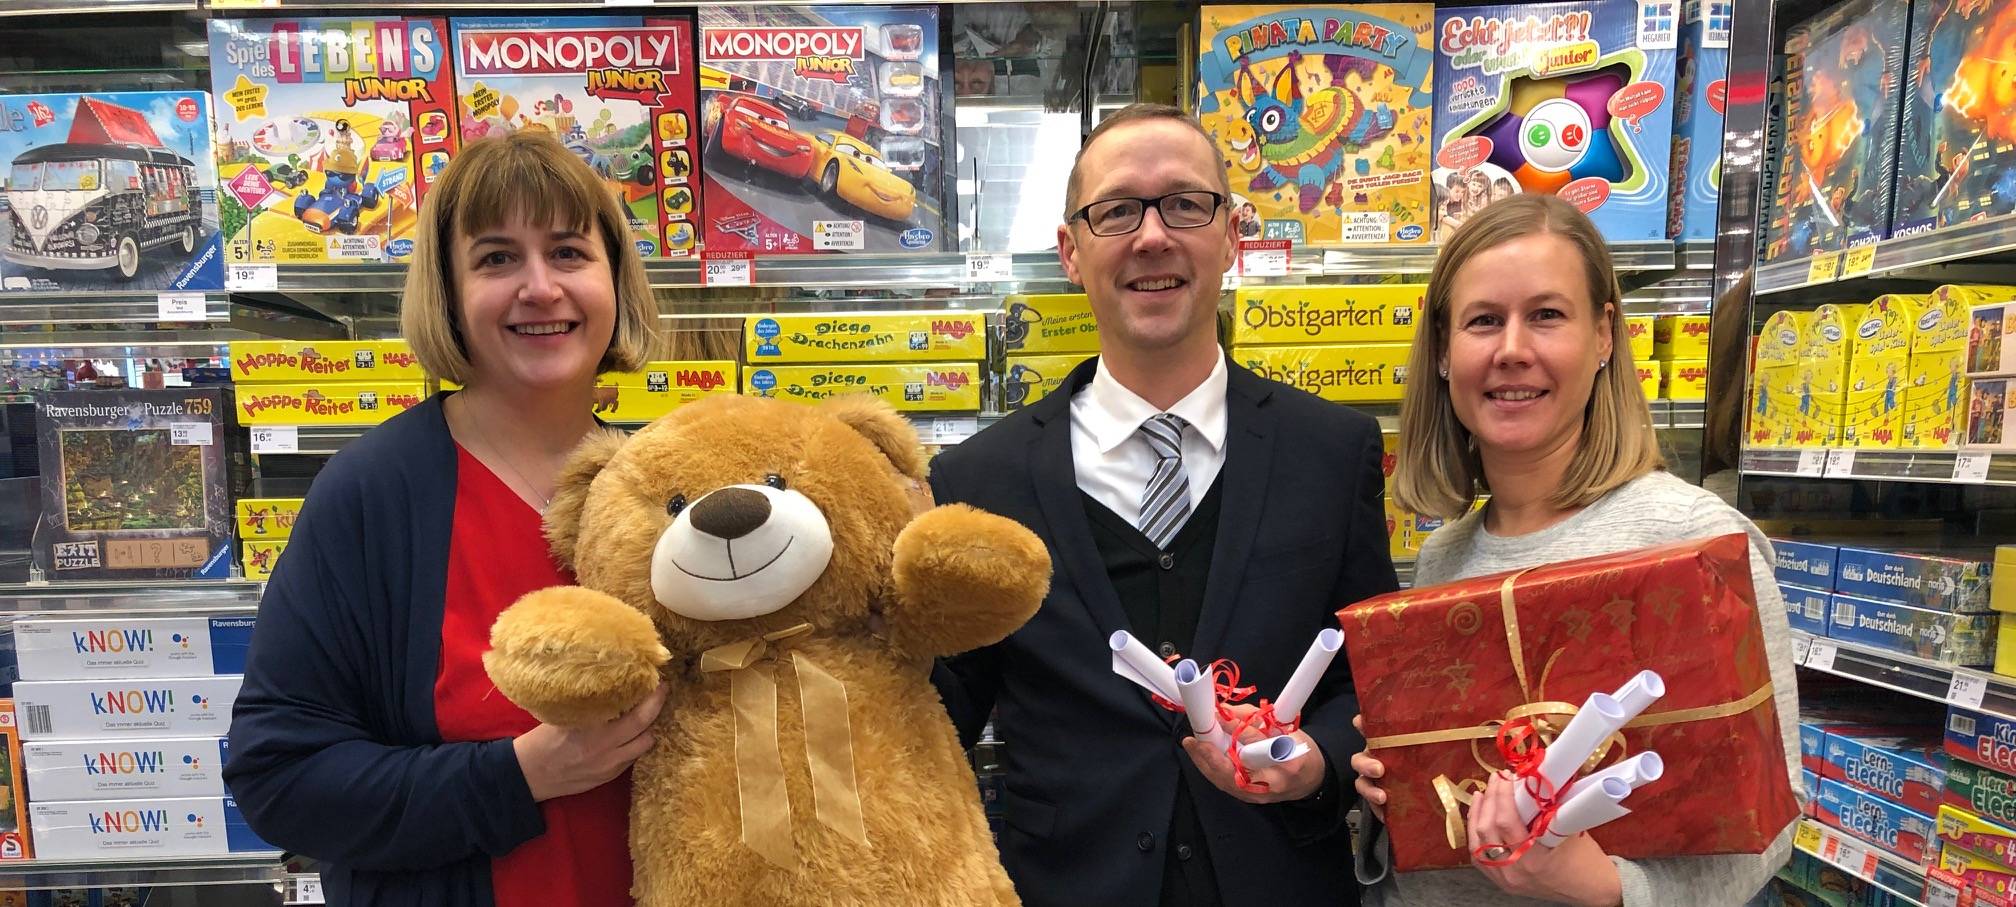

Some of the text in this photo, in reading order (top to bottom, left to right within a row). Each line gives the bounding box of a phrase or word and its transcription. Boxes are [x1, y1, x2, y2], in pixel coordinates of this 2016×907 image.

[709, 31, 859, 56] MONOPOLY
[1322, 18, 1407, 57] PARTY
[1442, 18, 1497, 50] Echt
[226, 26, 435, 74] Spiel LEBENS
[468, 34, 671, 70] MONOPOLY
[252, 62, 275, 77] des
[795, 57, 856, 75] JUNIOR
[343, 77, 433, 106] JUNIOR
[586, 69, 668, 94] JUNIOR
[1453, 77, 1475, 92] 1000
[34, 105, 52, 121] 162
[382, 171, 404, 187] STRAND
[903, 230, 931, 242] Hasbro
[1268, 228, 1280, 239] 4+
[1893, 222, 1933, 239] KOSMOS
[234, 247, 248, 259] 5+
[765, 239, 778, 249] 5+
[176, 245, 217, 290] Ravensburger
[815, 320, 871, 334] Diego
[931, 320, 974, 339] HABA
[1244, 301, 1384, 336] Obstgarten
[786, 333, 894, 350] Drachenzahn
[1042, 326, 1076, 338] Erster
[237, 352, 350, 376] Hoppe Reiter
[676, 369, 726, 391] HABA
[811, 372, 867, 386] Diego
[926, 371, 969, 391] HABA
[46, 398, 213, 419] Ravensburger Puzzle 759
[242, 394, 354, 418] Hoppe Reiter
[1872, 429, 1893, 445] HABA
[56, 543, 98, 557] EXIT
[201, 544, 229, 576] Ravensburger
[57, 558, 100, 569] PUZZLE
[1867, 568, 1921, 590] Deutschland
[1860, 613, 1914, 637] Deutschland
[72, 629, 154, 654] kNOW!
[91, 690, 174, 715] kNOW!
[84, 751, 164, 775] kNOW!
[1863, 748, 1893, 771] Lern-
[1846, 757, 1904, 799] Electric
[1857, 795, 1887, 819] Lern-
[89, 810, 168, 833] kNOW!
